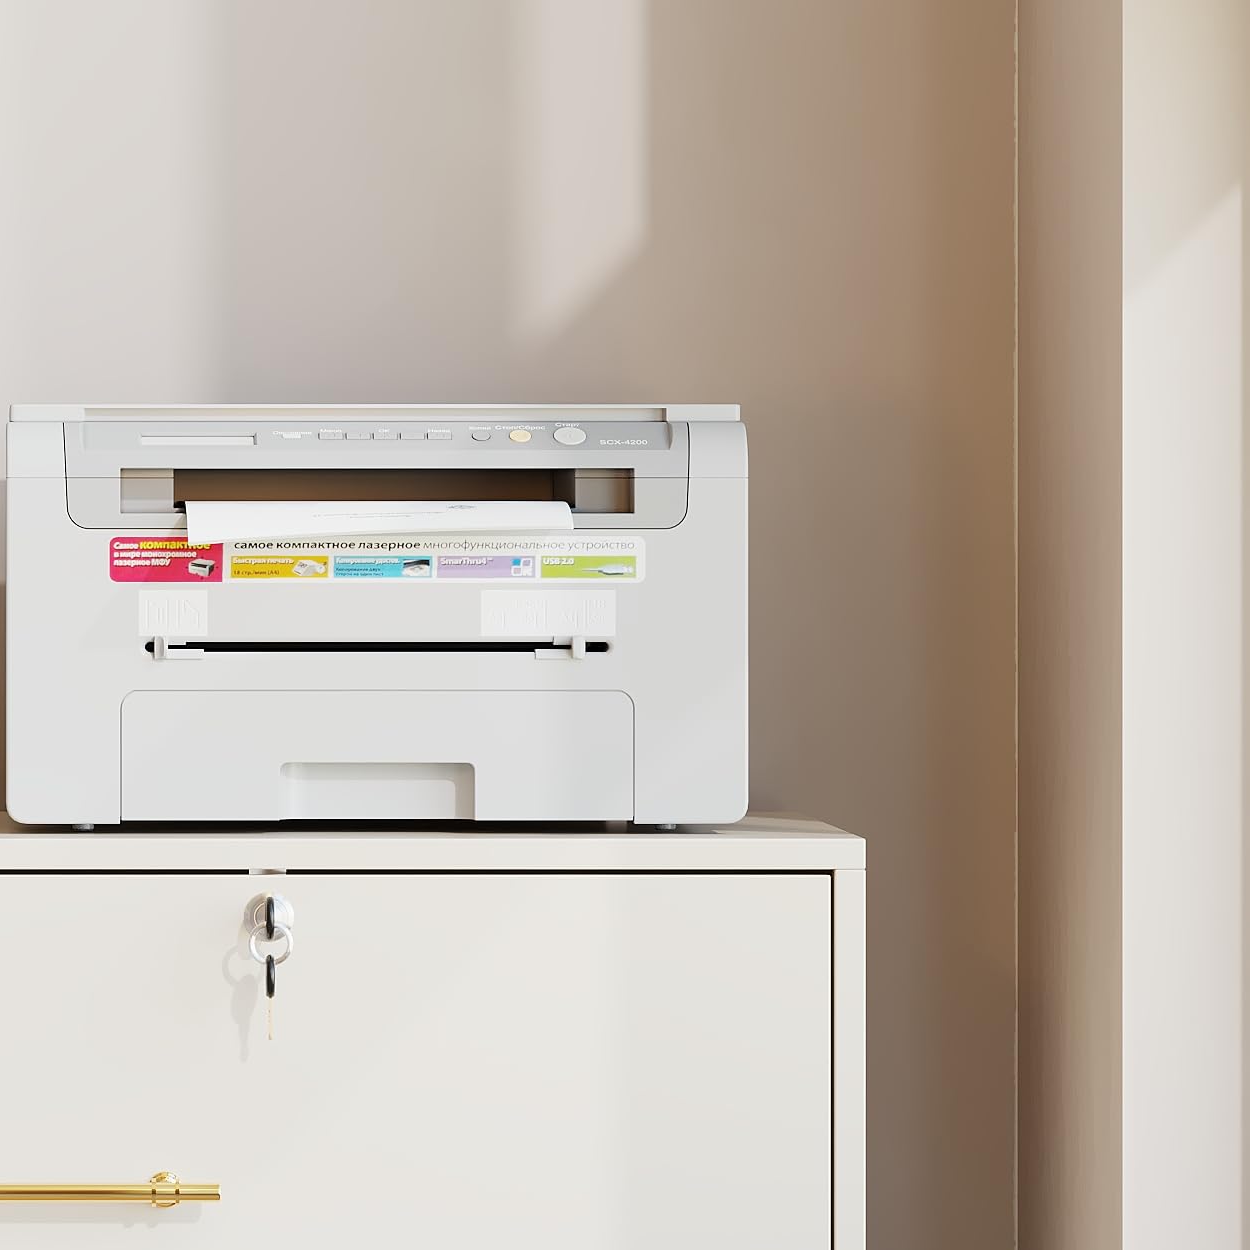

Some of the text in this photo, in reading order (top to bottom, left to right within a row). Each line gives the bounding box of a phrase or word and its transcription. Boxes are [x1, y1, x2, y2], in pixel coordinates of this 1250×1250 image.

[358, 542, 421, 551] лазерное
[423, 540, 565, 551] многофункциональное
[567, 540, 635, 551] устройство
[543, 557, 575, 565] USB 2.0
